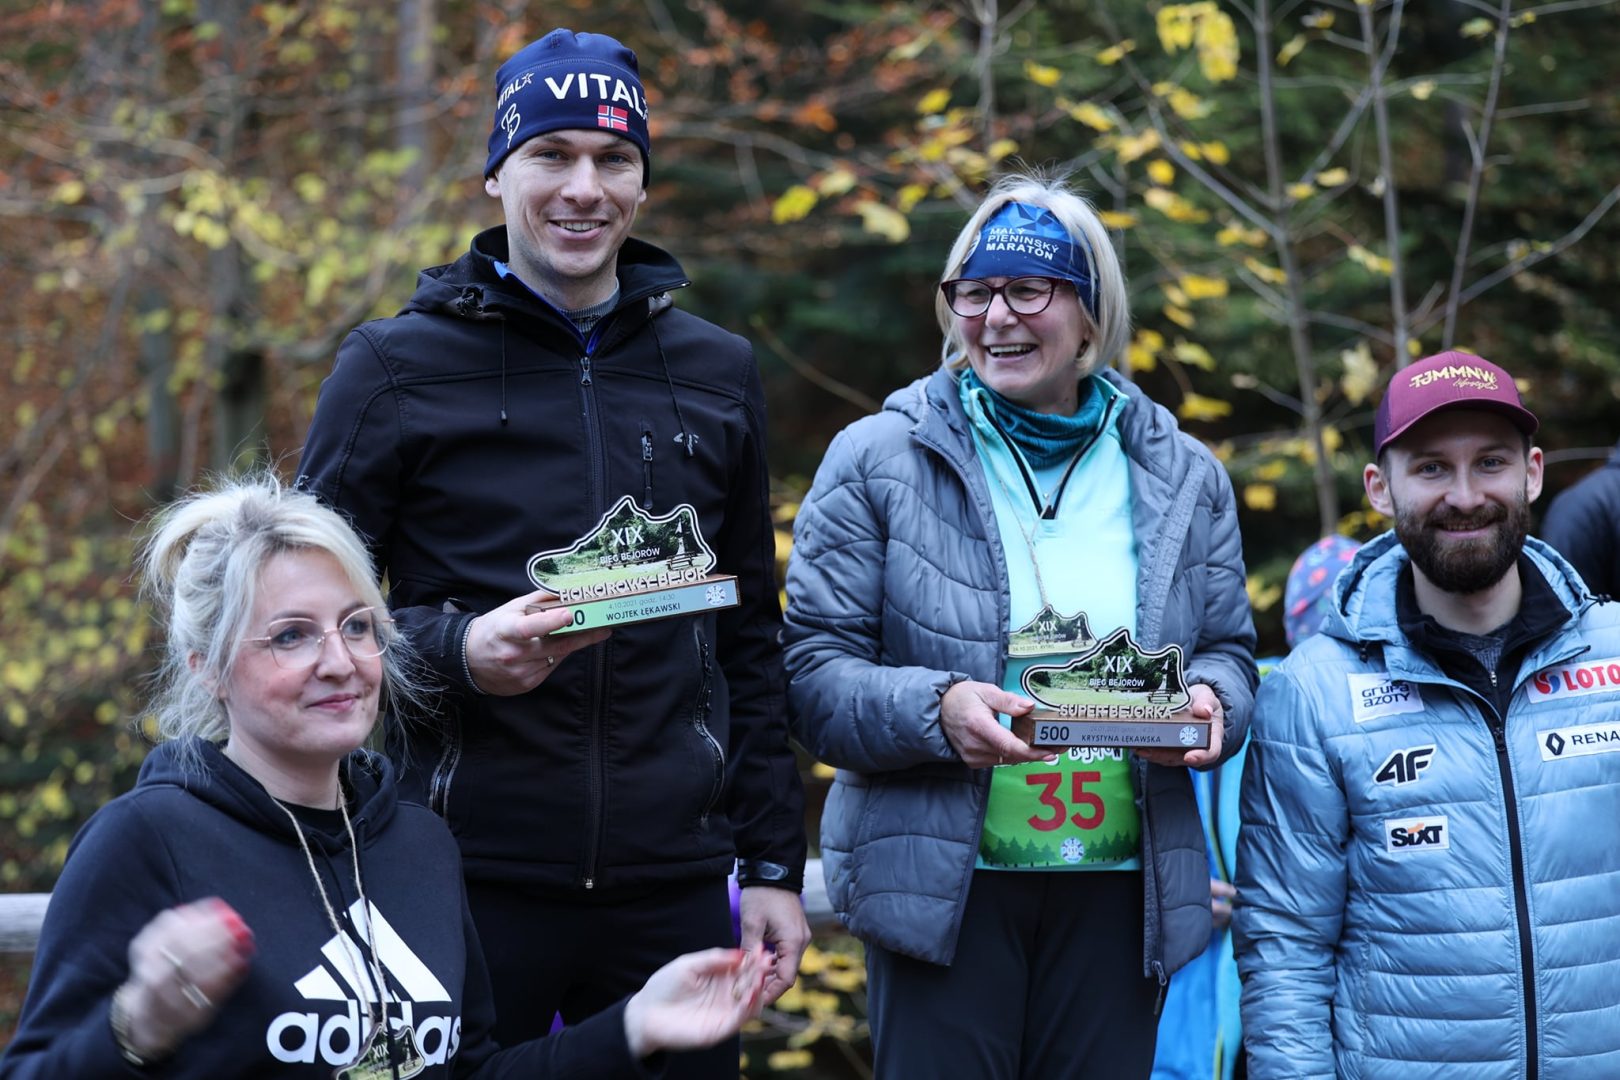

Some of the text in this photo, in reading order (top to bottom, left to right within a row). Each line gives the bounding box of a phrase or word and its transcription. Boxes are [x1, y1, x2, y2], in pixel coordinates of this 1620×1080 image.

[544, 73, 643, 118] VITAL
[611, 525, 645, 547] XIX
[599, 547, 660, 566] BIEG BEJORÓW
[606, 602, 681, 621] WOJTEK ŁĘKAWSKI
[1038, 620, 1058, 632] XIX
[1104, 655, 1133, 673] XIX
[1089, 677, 1146, 687] BIEG BEJORÓW
[1039, 726, 1070, 742] 500
[1081, 734, 1119, 742] KRYSTYNA
[1026, 771, 1105, 832] 35
[371, 1043, 389, 1059] XIX
